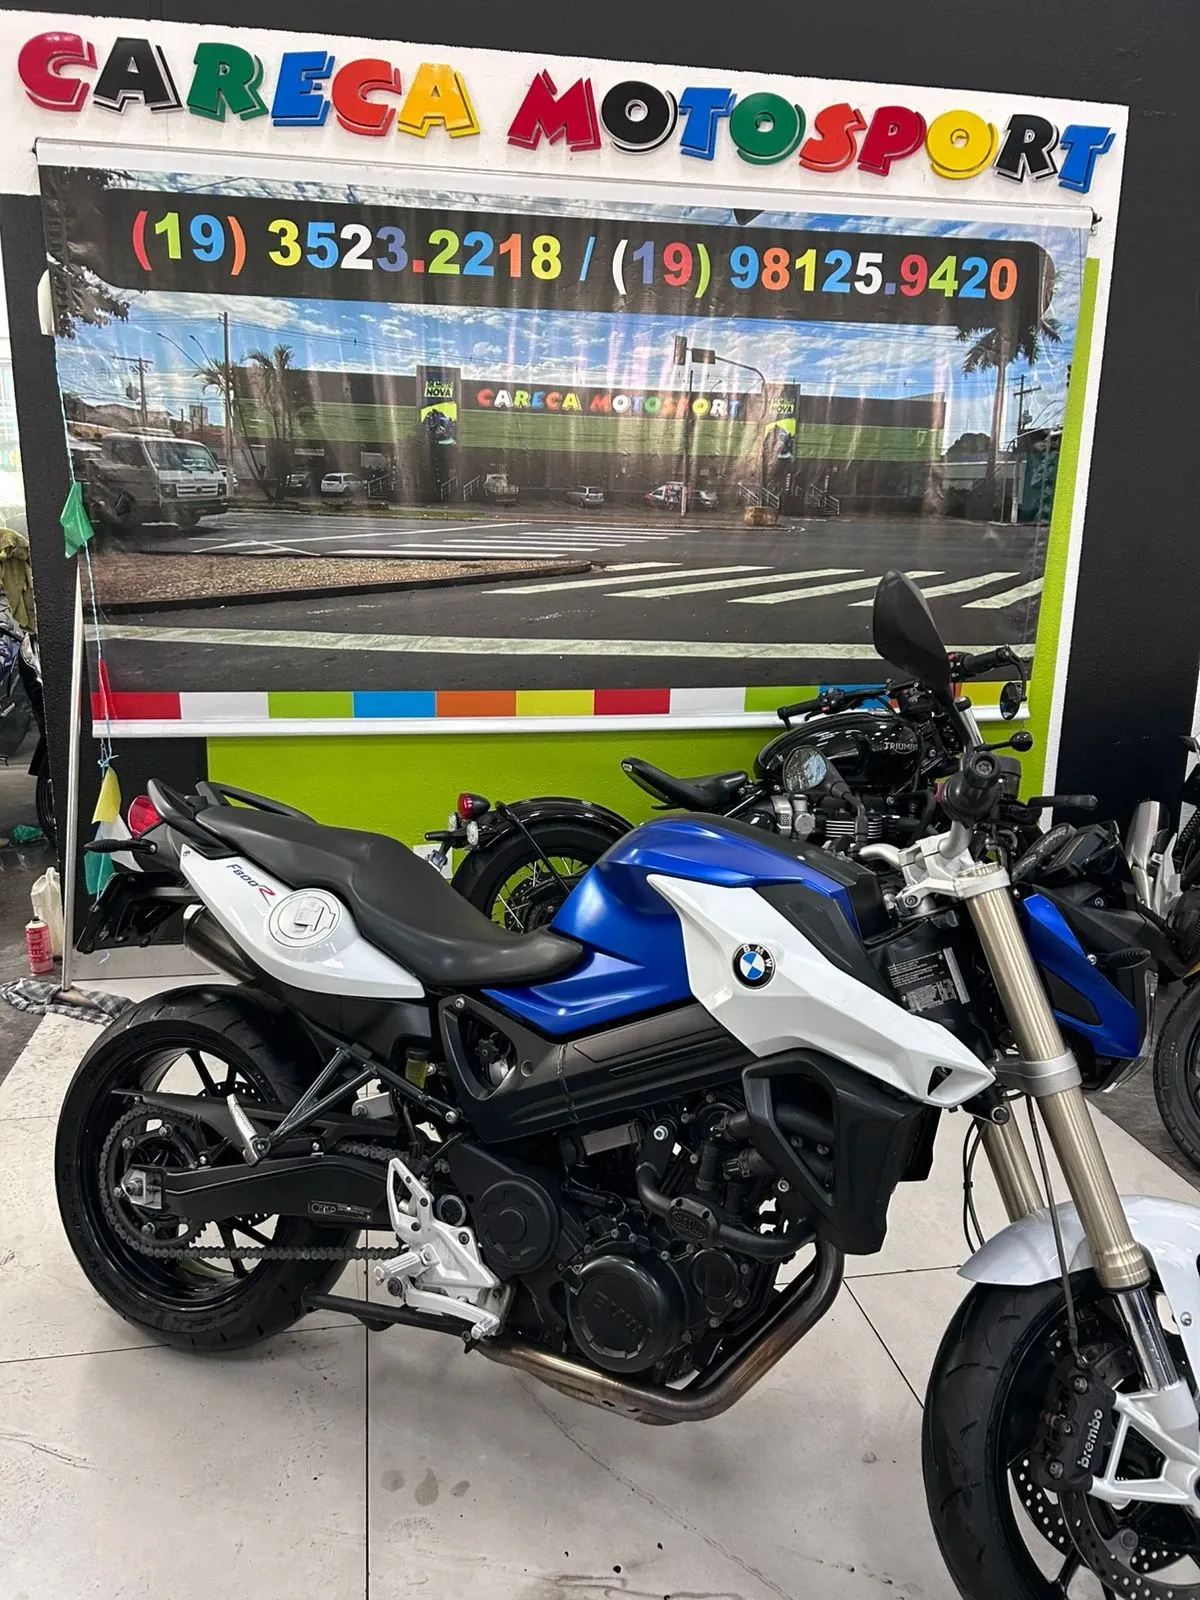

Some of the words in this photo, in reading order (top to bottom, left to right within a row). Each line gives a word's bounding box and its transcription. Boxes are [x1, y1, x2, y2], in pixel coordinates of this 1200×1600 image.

[17, 31, 480, 139] CARECA
[508, 69, 1116, 193] MOTOSPORT
[132, 211, 246, 275] (19)
[268, 219, 562, 281] 3523.2218
[612, 239, 711, 298] (19)
[730, 245, 1017, 300] 98125.9420
[426, 388, 451, 396] NOVA
[476, 388, 582, 413] CARECA
[883, 741, 918, 752] TRIUMPH
[742, 944, 773, 967] BMW
[1077, 1409, 1103, 1468] brembo
